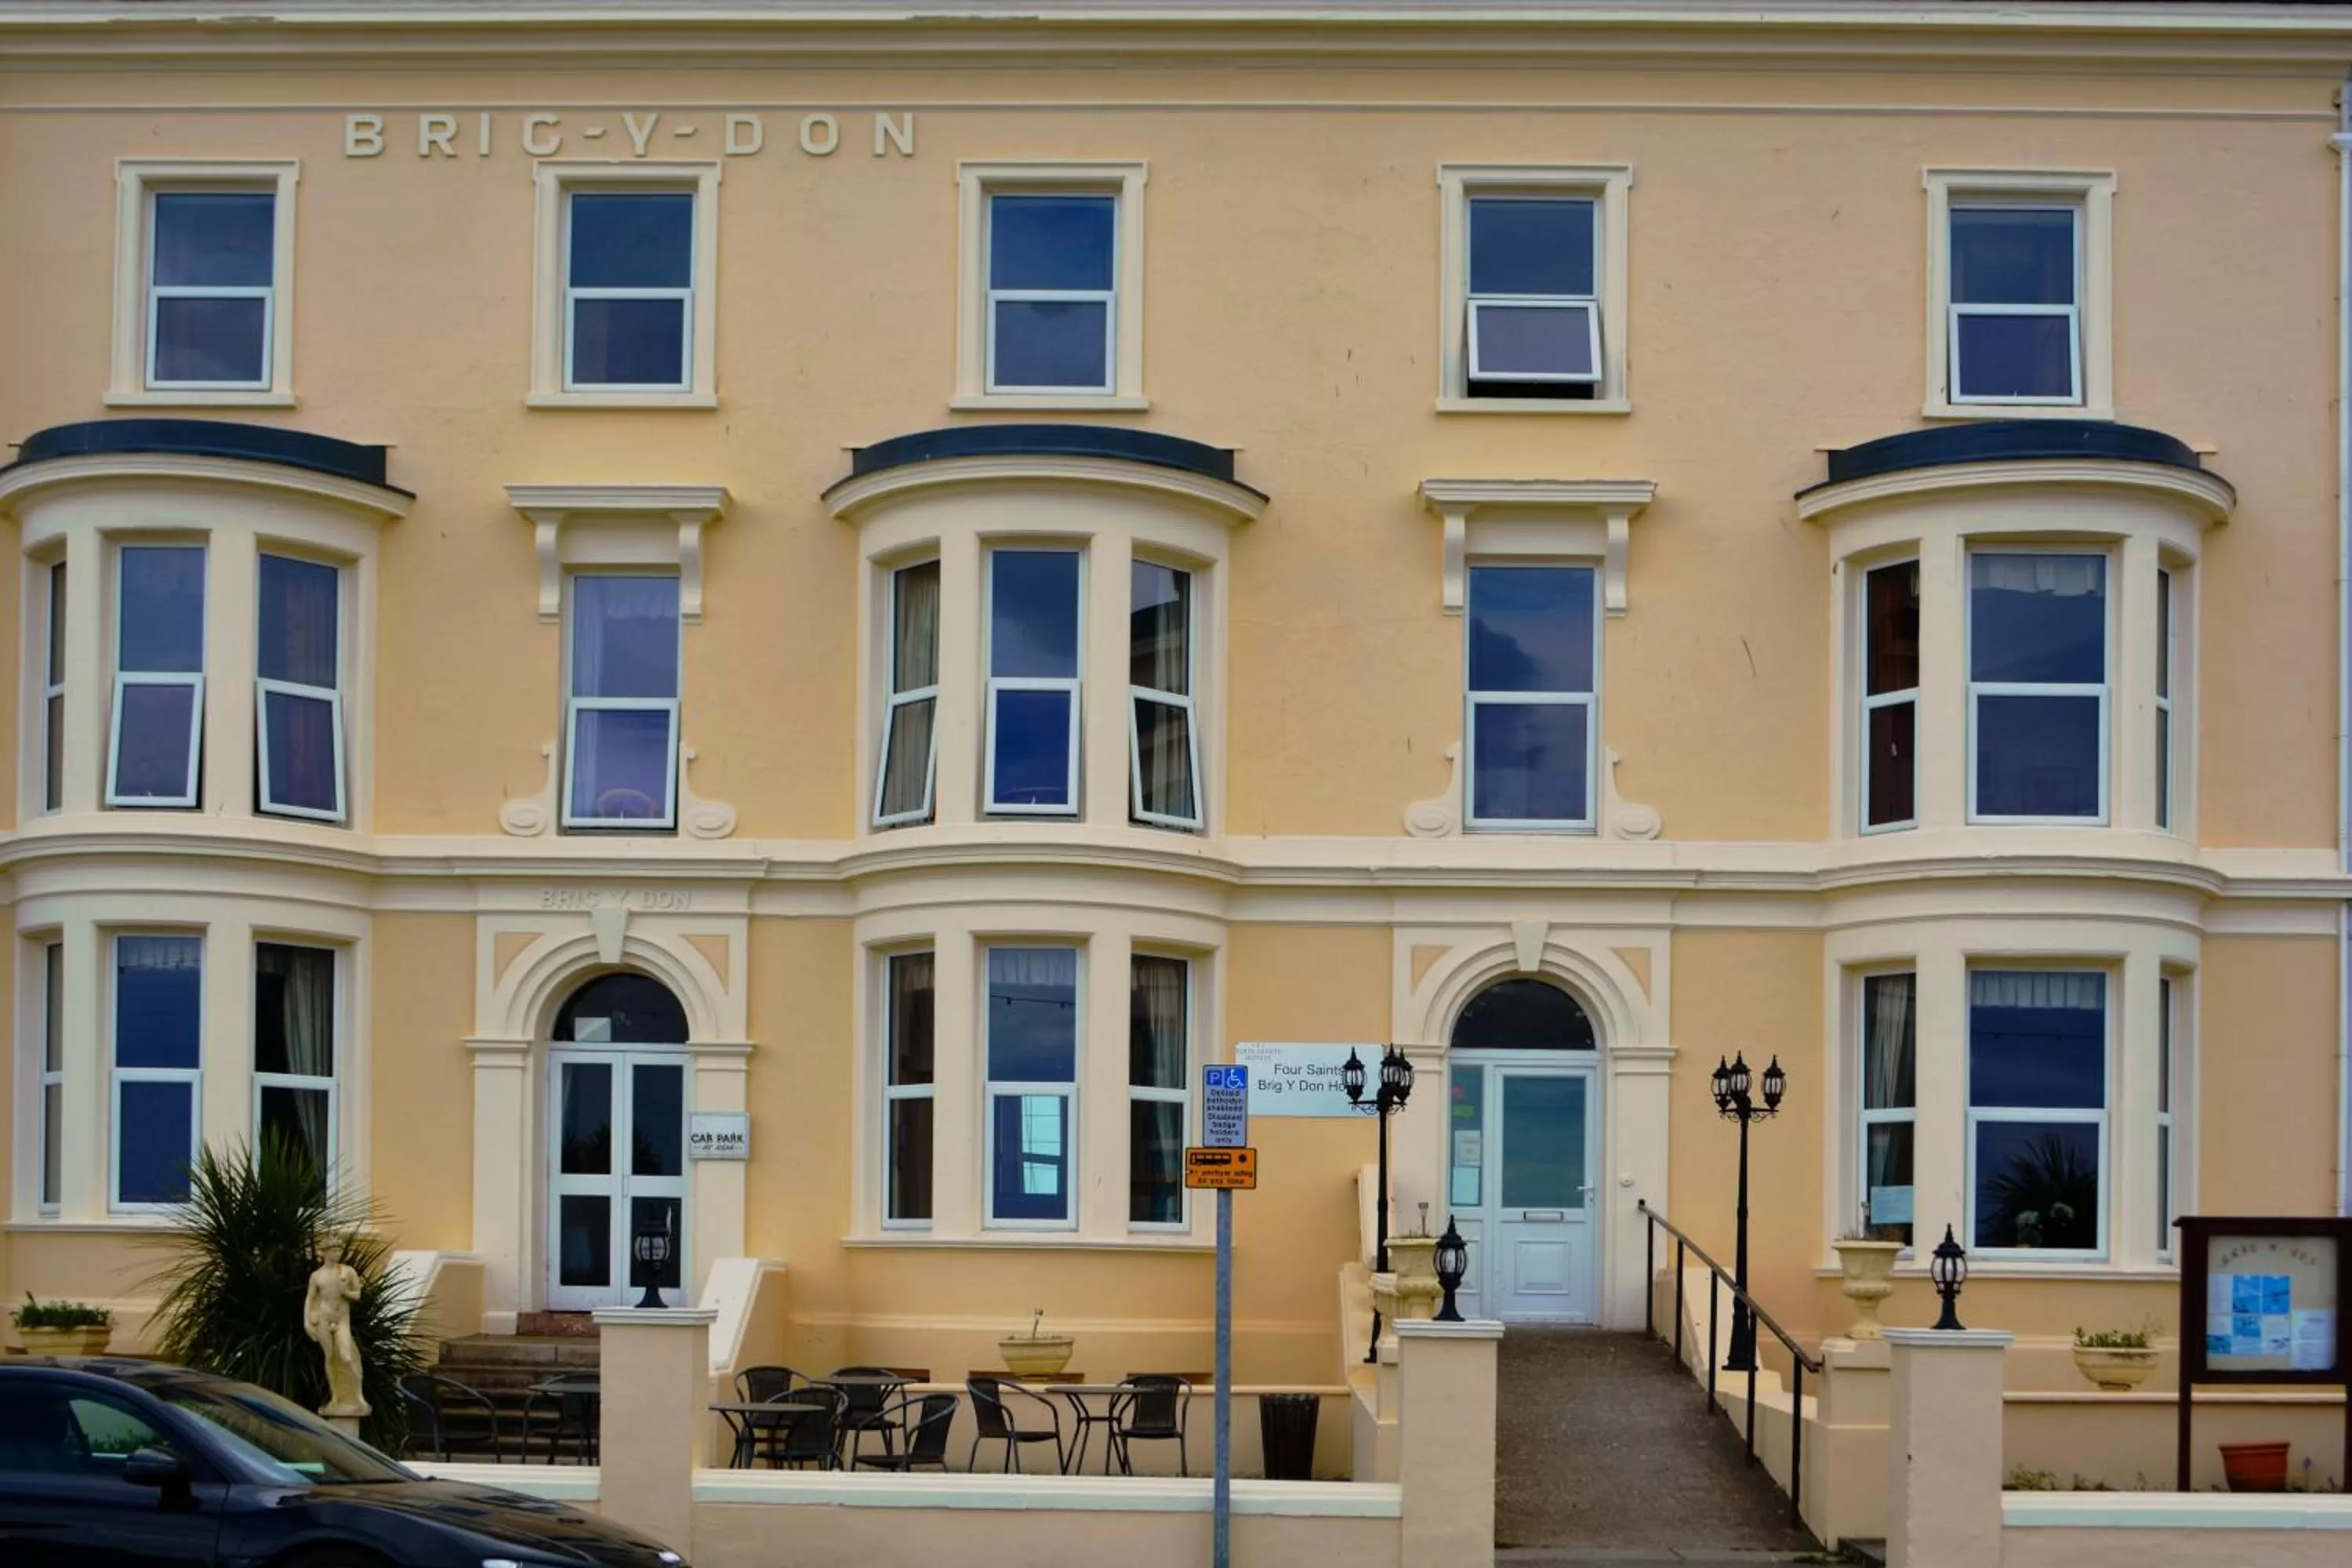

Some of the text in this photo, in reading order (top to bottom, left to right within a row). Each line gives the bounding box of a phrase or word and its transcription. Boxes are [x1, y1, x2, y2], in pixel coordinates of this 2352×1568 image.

[641, 890, 692, 909] DON
[1274, 1064, 1302, 1076] Four
[1210, 1072, 1221, 1084] P
[1258, 1080, 1283, 1093] Brig
[1287, 1080, 1296, 1091] Y
[1299, 1080, 1324, 1091] Don
[691, 1132, 743, 1144] CAR PARK
